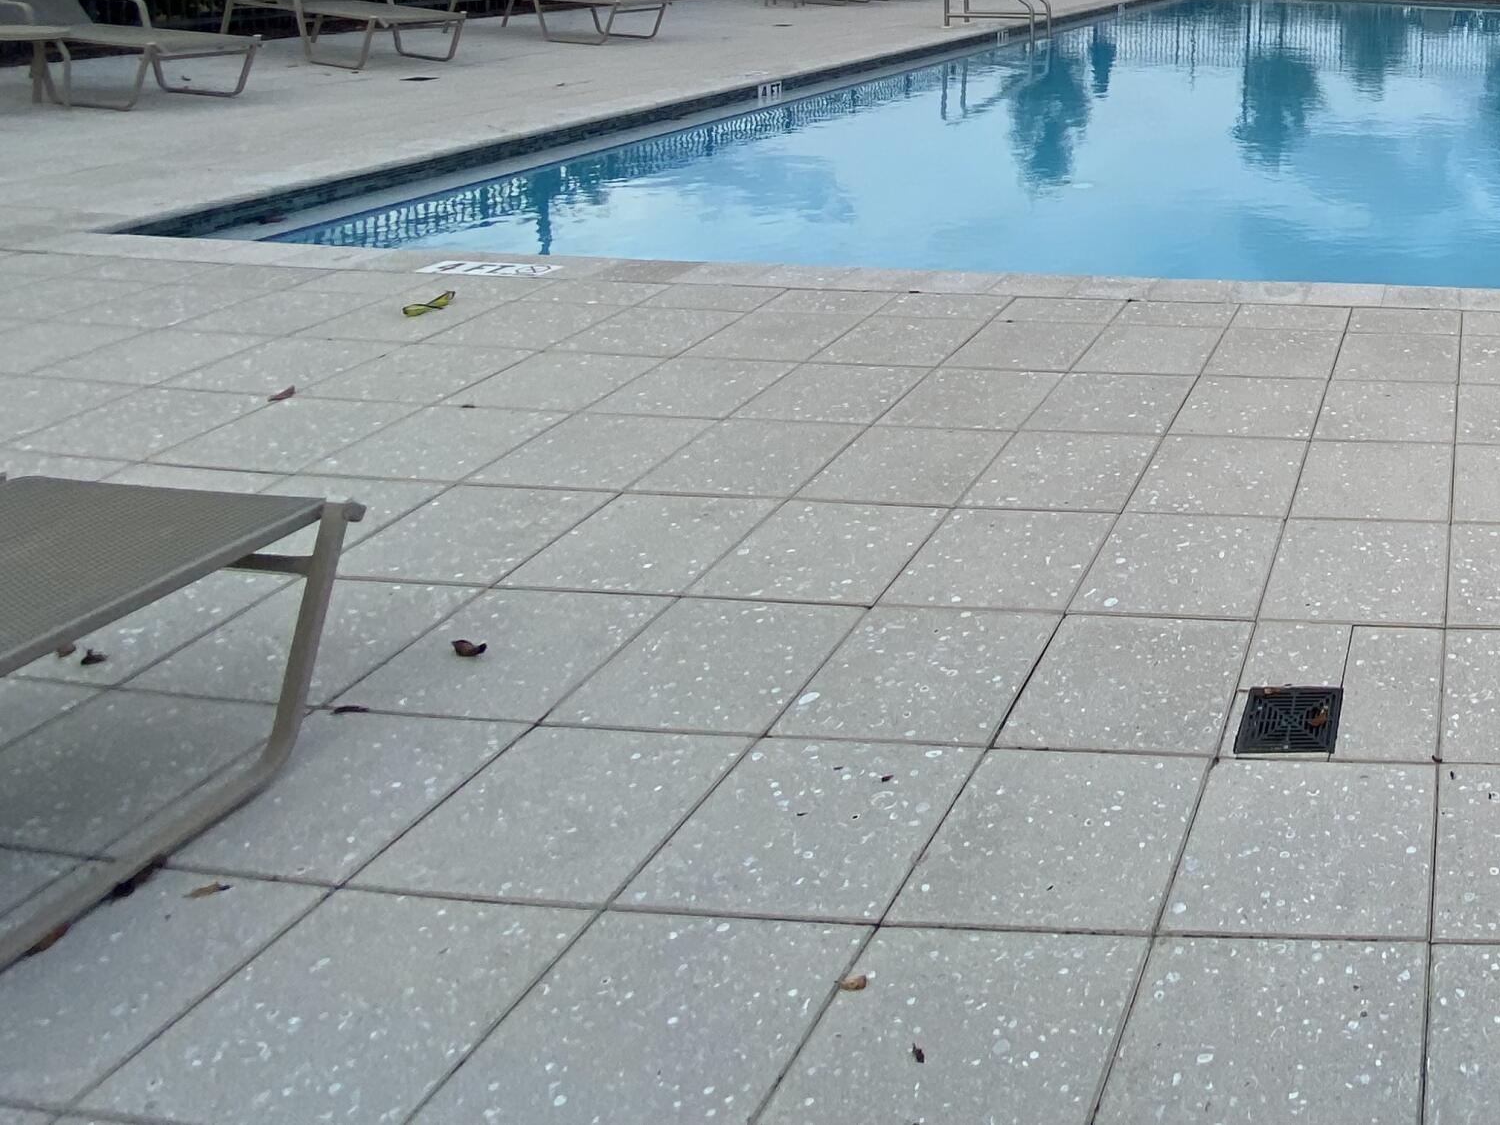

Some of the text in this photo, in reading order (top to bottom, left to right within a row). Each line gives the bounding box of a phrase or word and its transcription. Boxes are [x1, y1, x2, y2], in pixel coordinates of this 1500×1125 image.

[761, 83, 781, 98] 4 FT
[437, 262, 466, 272] 4
